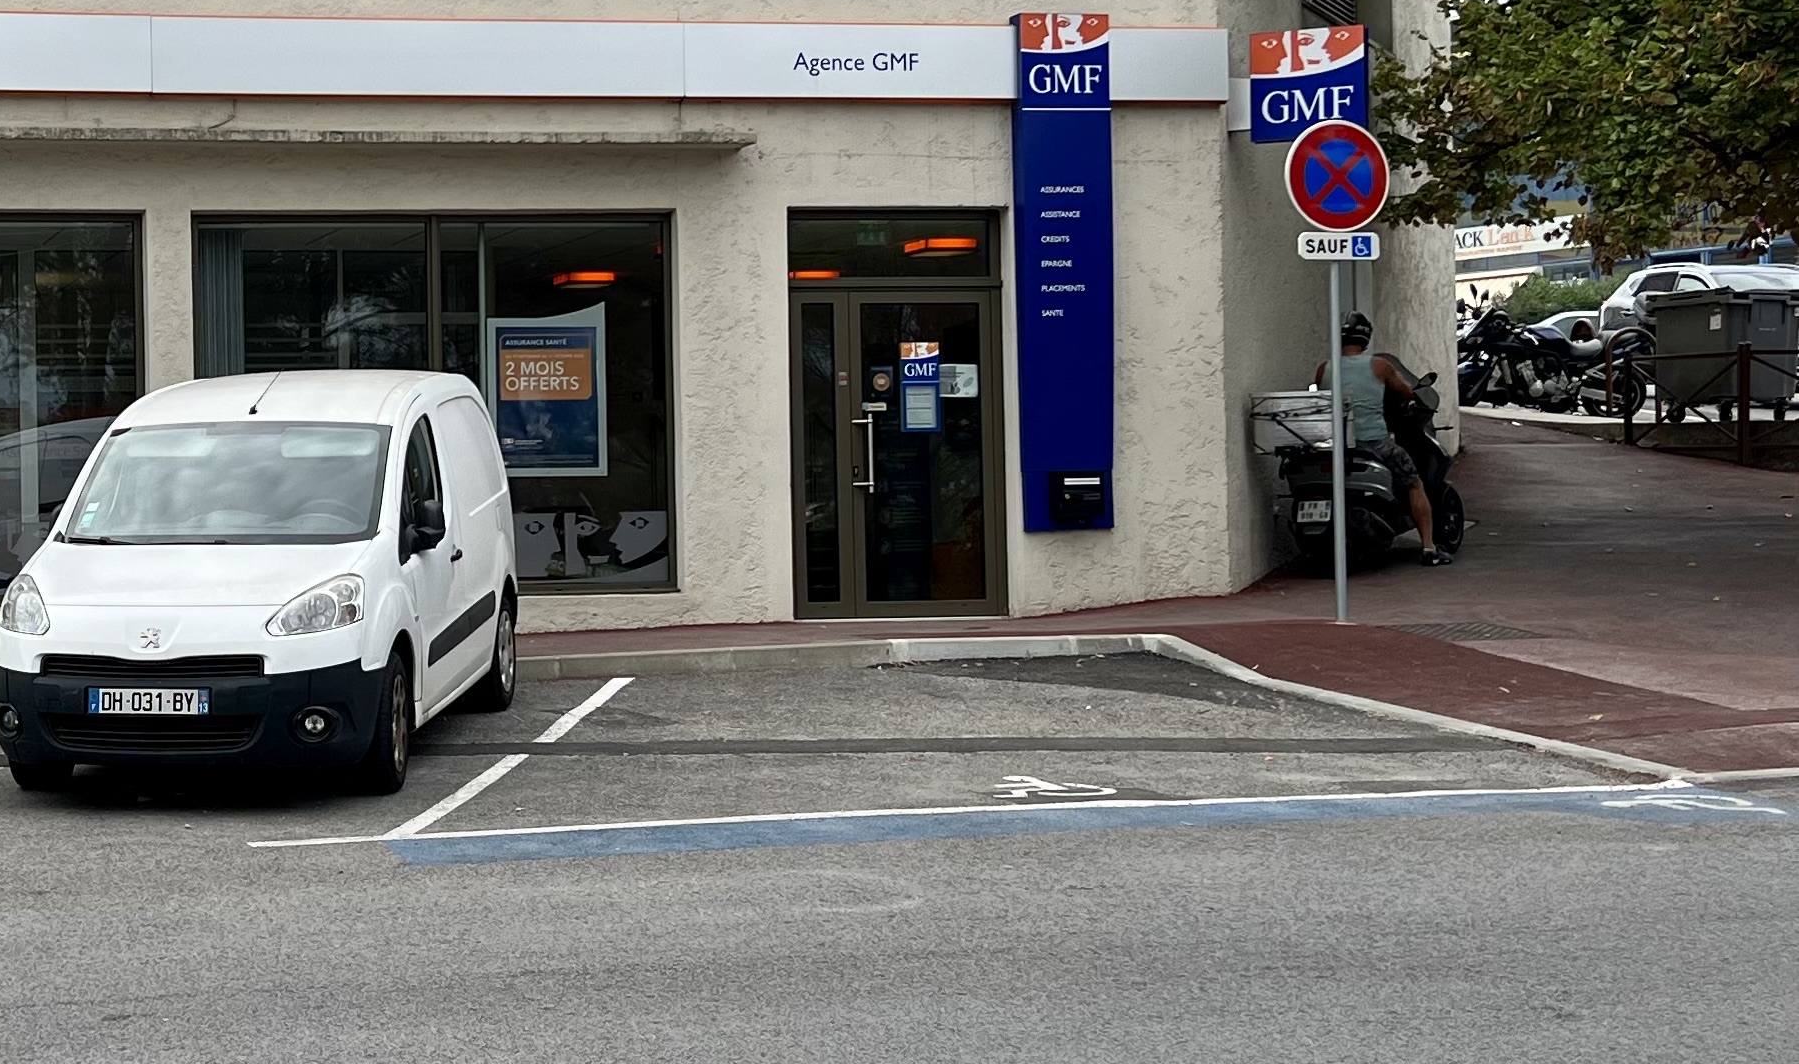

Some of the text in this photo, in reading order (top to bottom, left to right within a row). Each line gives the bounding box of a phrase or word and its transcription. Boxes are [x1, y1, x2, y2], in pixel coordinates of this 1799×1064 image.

[793, 52, 920, 77] Agence GMF
[1028, 63, 1103, 95] GMF
[1261, 85, 1355, 125] GMF
[1040, 186, 1085, 194] ASSURANCES
[1040, 210, 1081, 218] ASSISTANCE
[1040, 235, 1071, 243] CREDITS
[1305, 239, 1349, 254] SAUF
[1041, 260, 1073, 268] EPARGNE
[1041, 285, 1086, 293] PLACEMENTS
[1041, 309, 1064, 317] SANTE
[505, 361, 564, 375] 2 MOIS
[904, 363, 937, 377] GMF
[101, 692, 194, 712] DH-031-BY
[198, 702, 209, 713] 13
